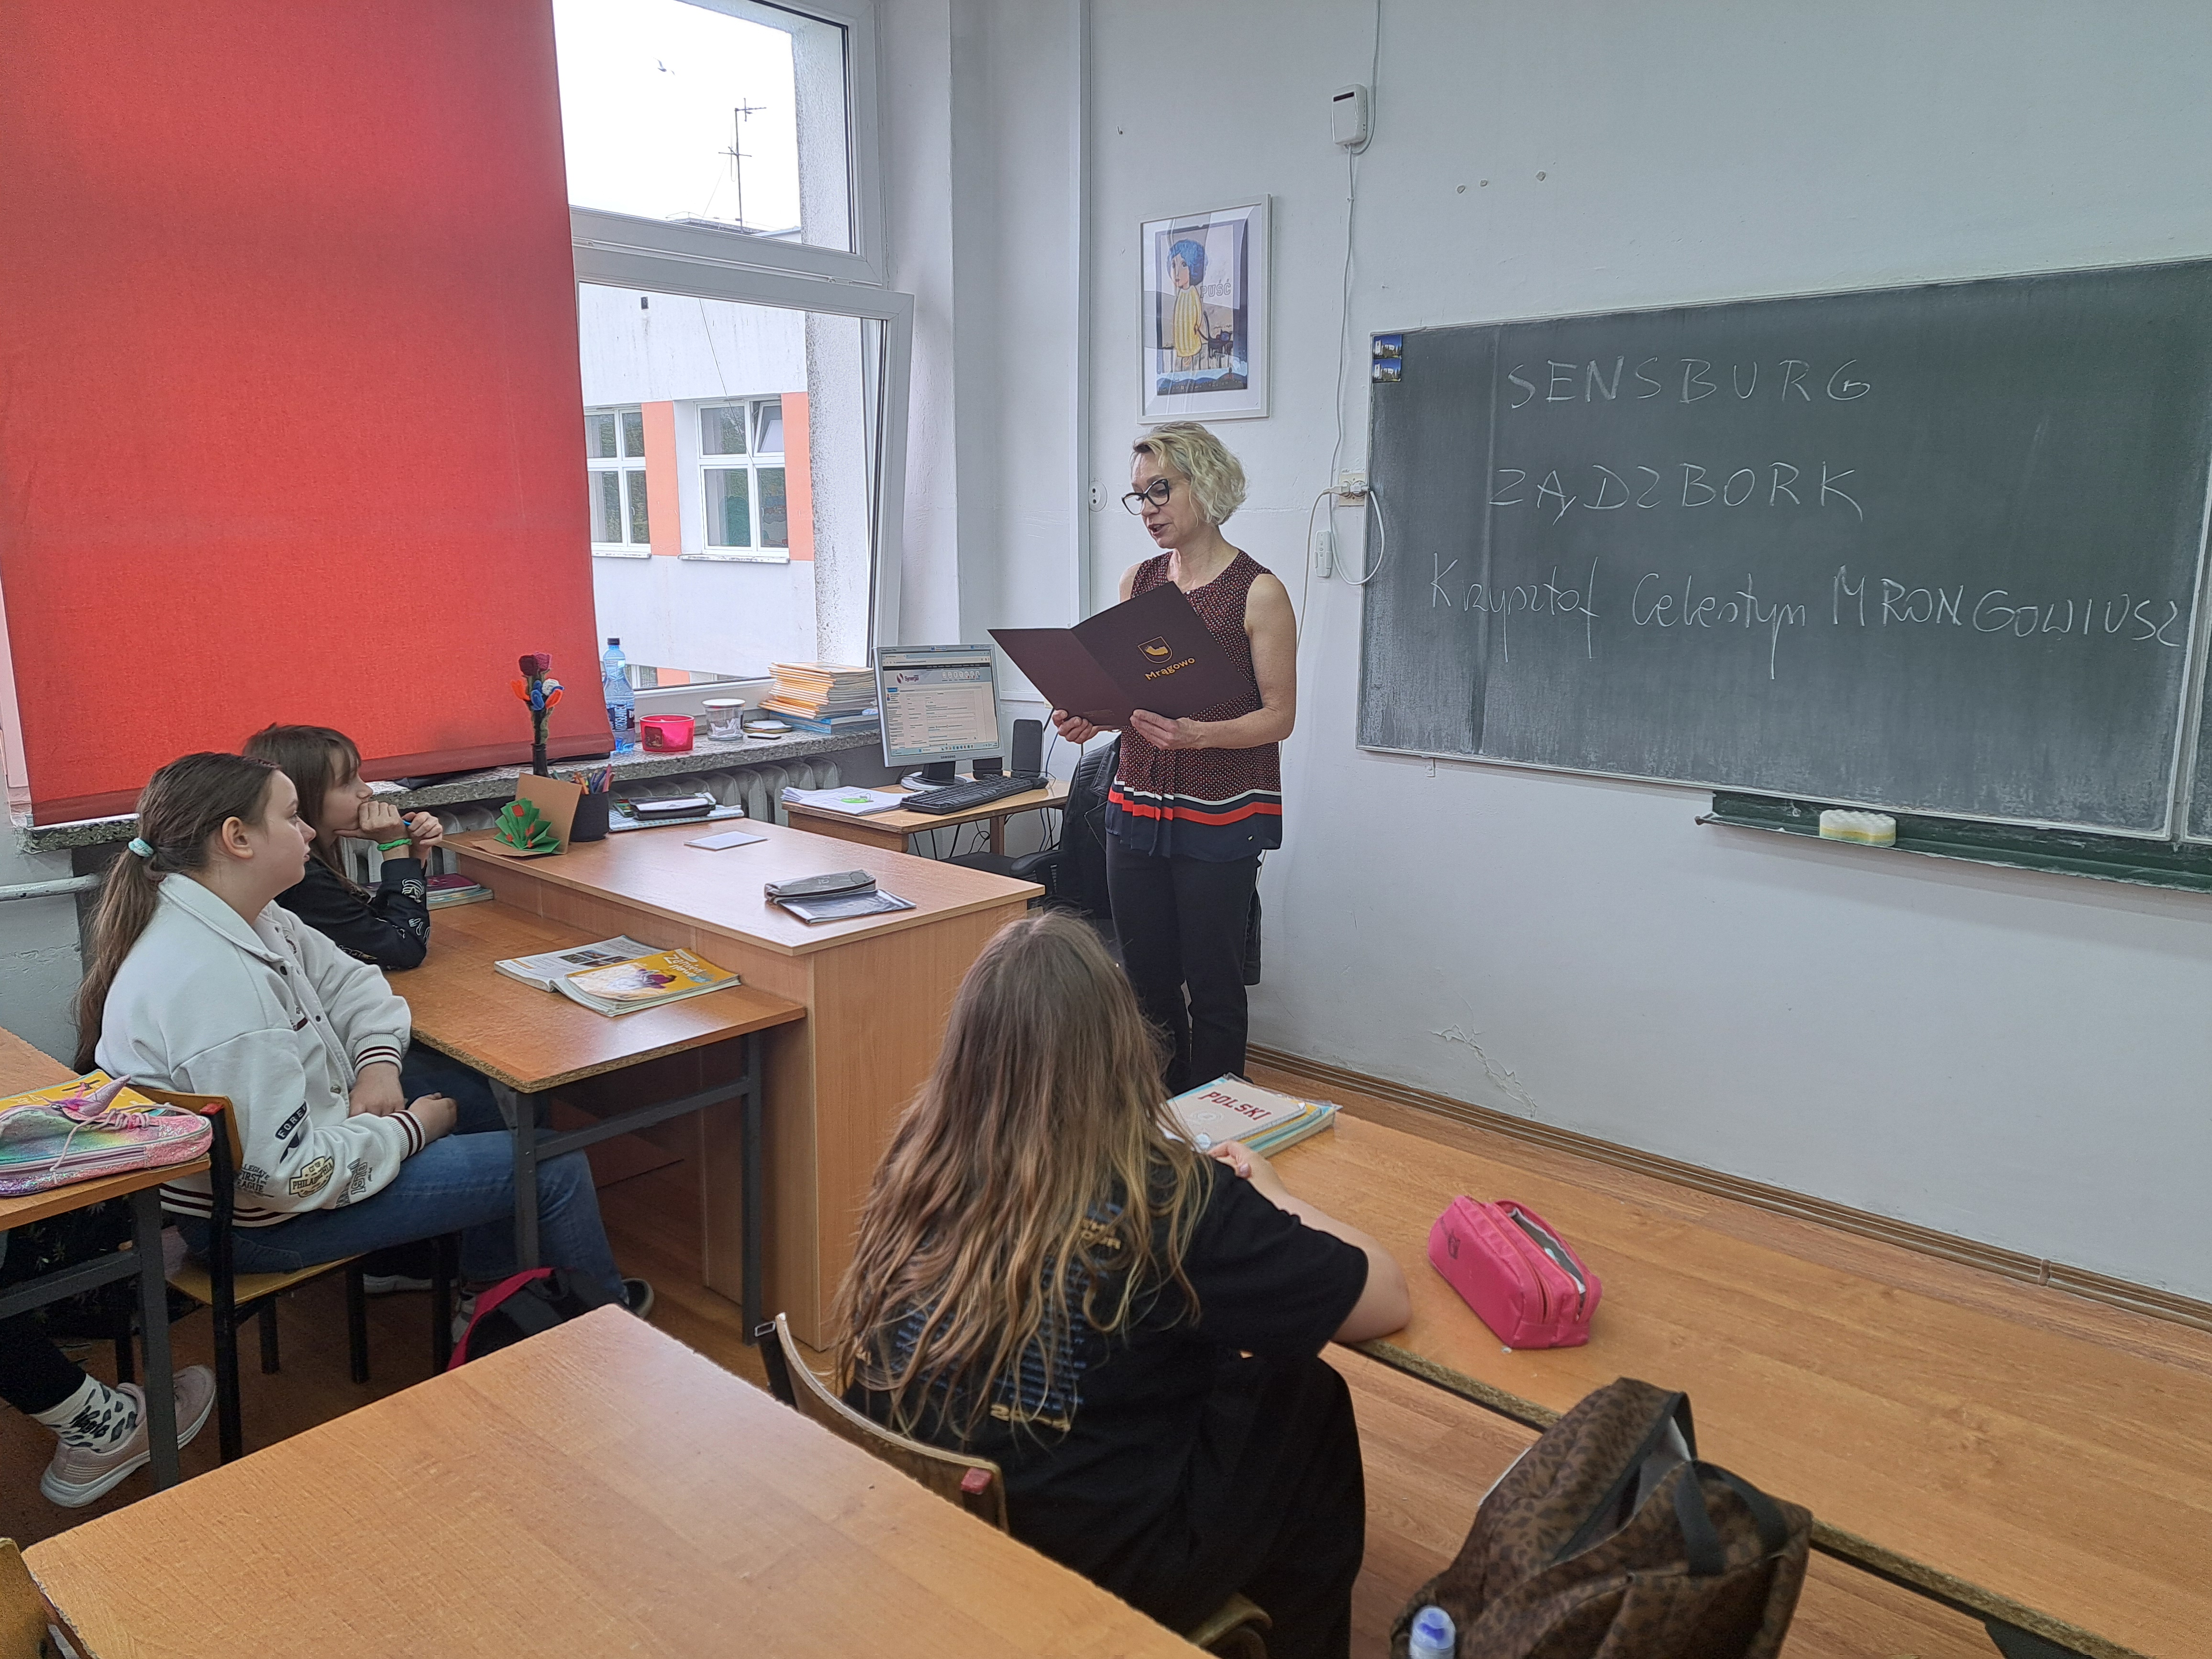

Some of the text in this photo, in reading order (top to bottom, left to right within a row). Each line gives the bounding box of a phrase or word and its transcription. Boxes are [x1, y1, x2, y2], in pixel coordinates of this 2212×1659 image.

[1200, 278, 1231, 299] PUŚĆ
[1507, 356, 1871, 409] SENSBURG
[1197, 1091, 1272, 1121] POLSKI
